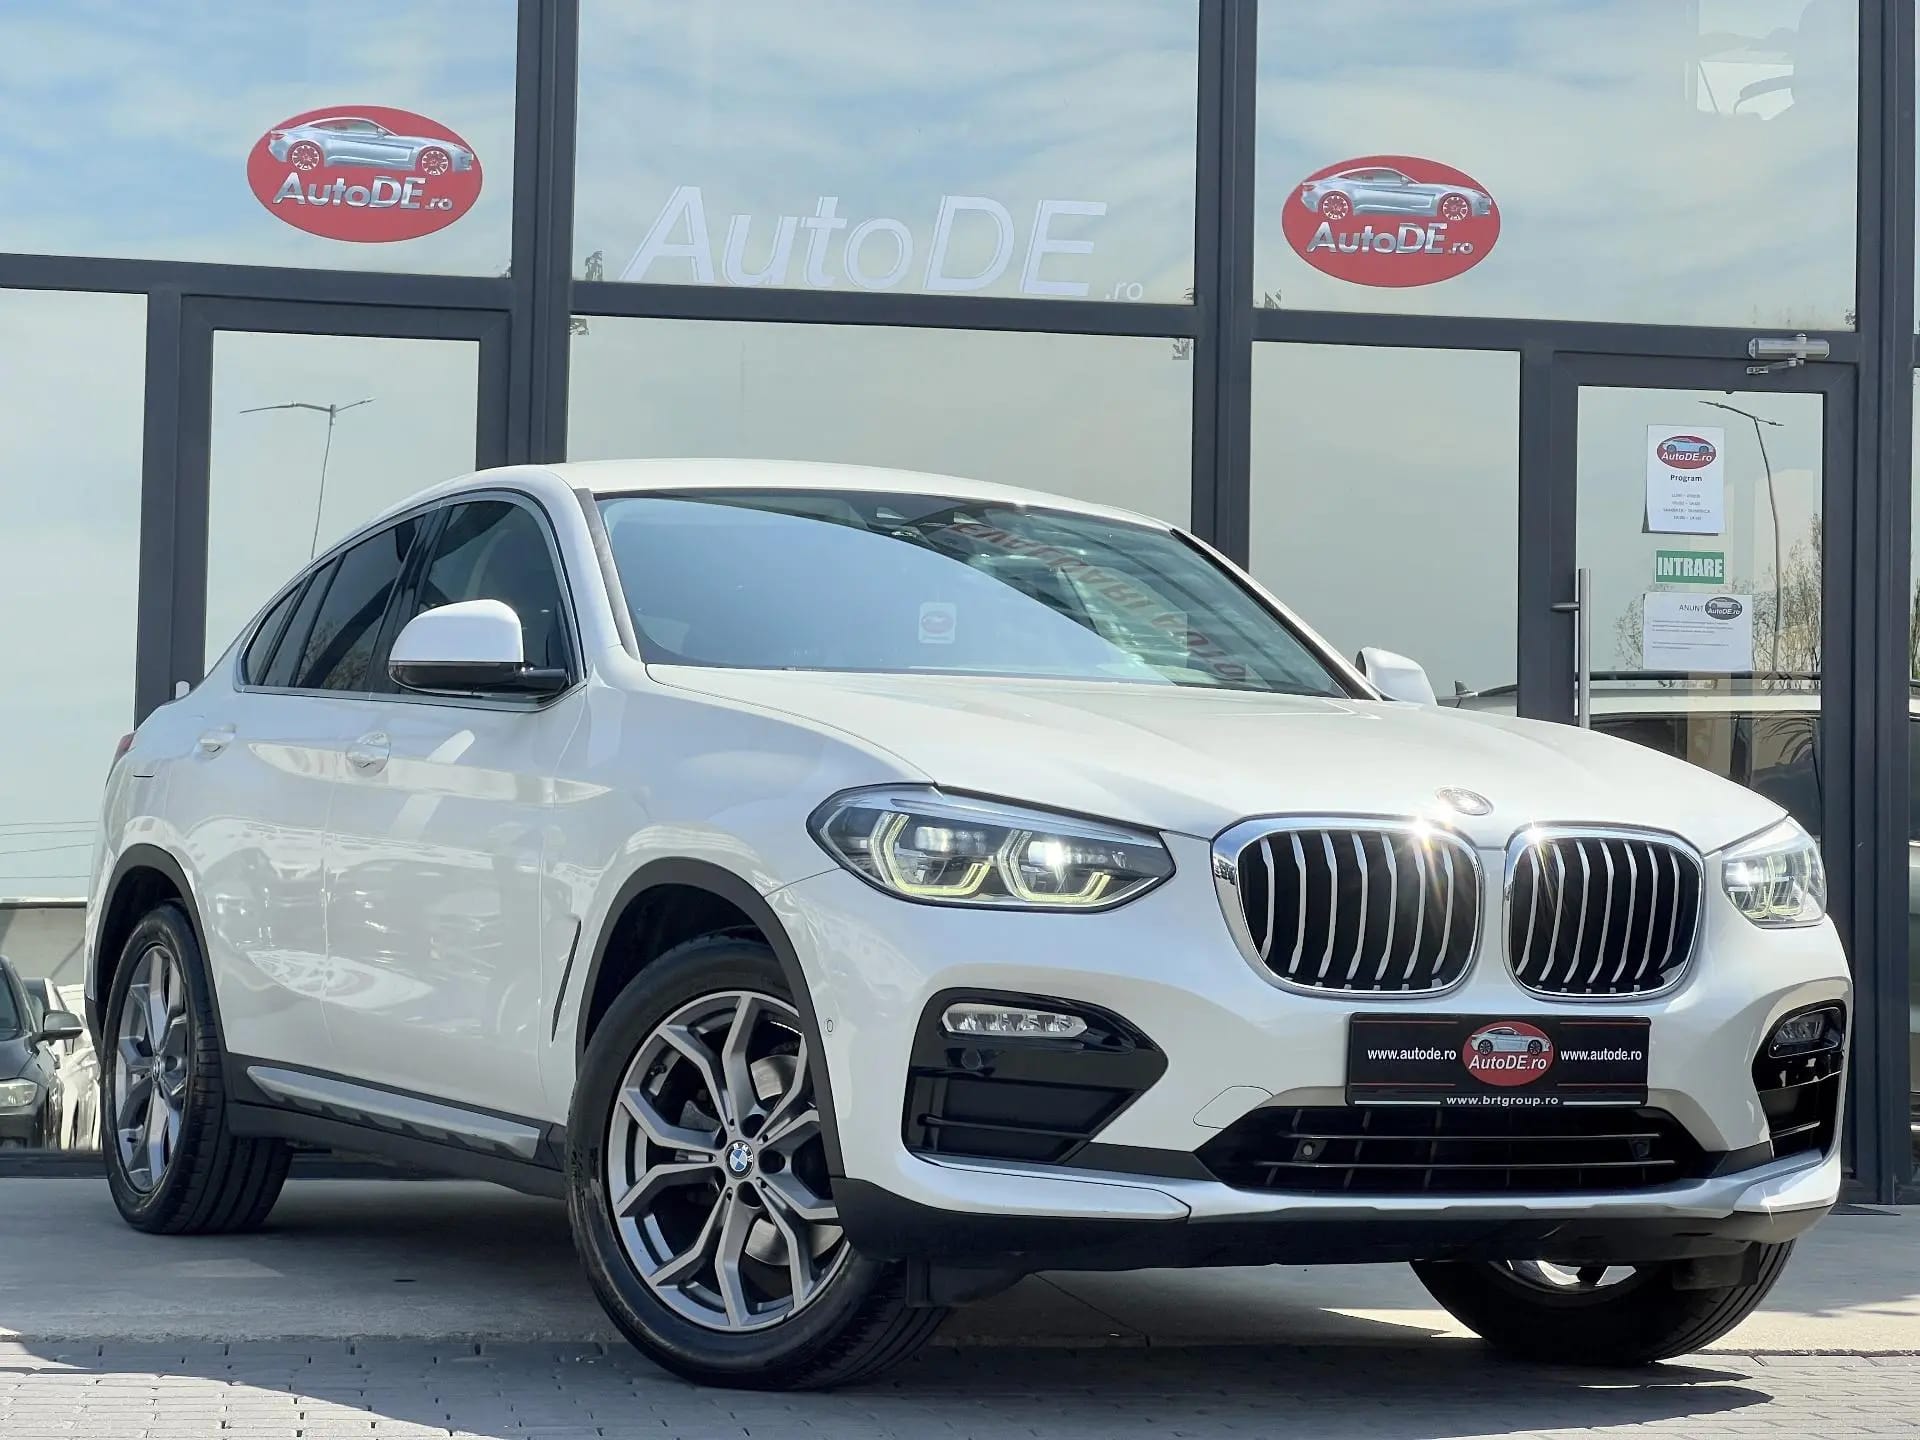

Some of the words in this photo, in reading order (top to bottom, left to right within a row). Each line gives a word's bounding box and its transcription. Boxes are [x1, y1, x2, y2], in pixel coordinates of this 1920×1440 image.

[1661, 451, 1713, 462] AutoDE.ro
[1670, 474, 1703, 483] Program
[1657, 557, 1723, 578] INTRARE
[1367, 1047, 1457, 1061] www.autode.ro
[1560, 1047, 1643, 1061] www.autode.ro
[1468, 1054, 1548, 1071] AutoDE.ro
[1446, 1095, 1559, 1107] www.brtgroup.ro
